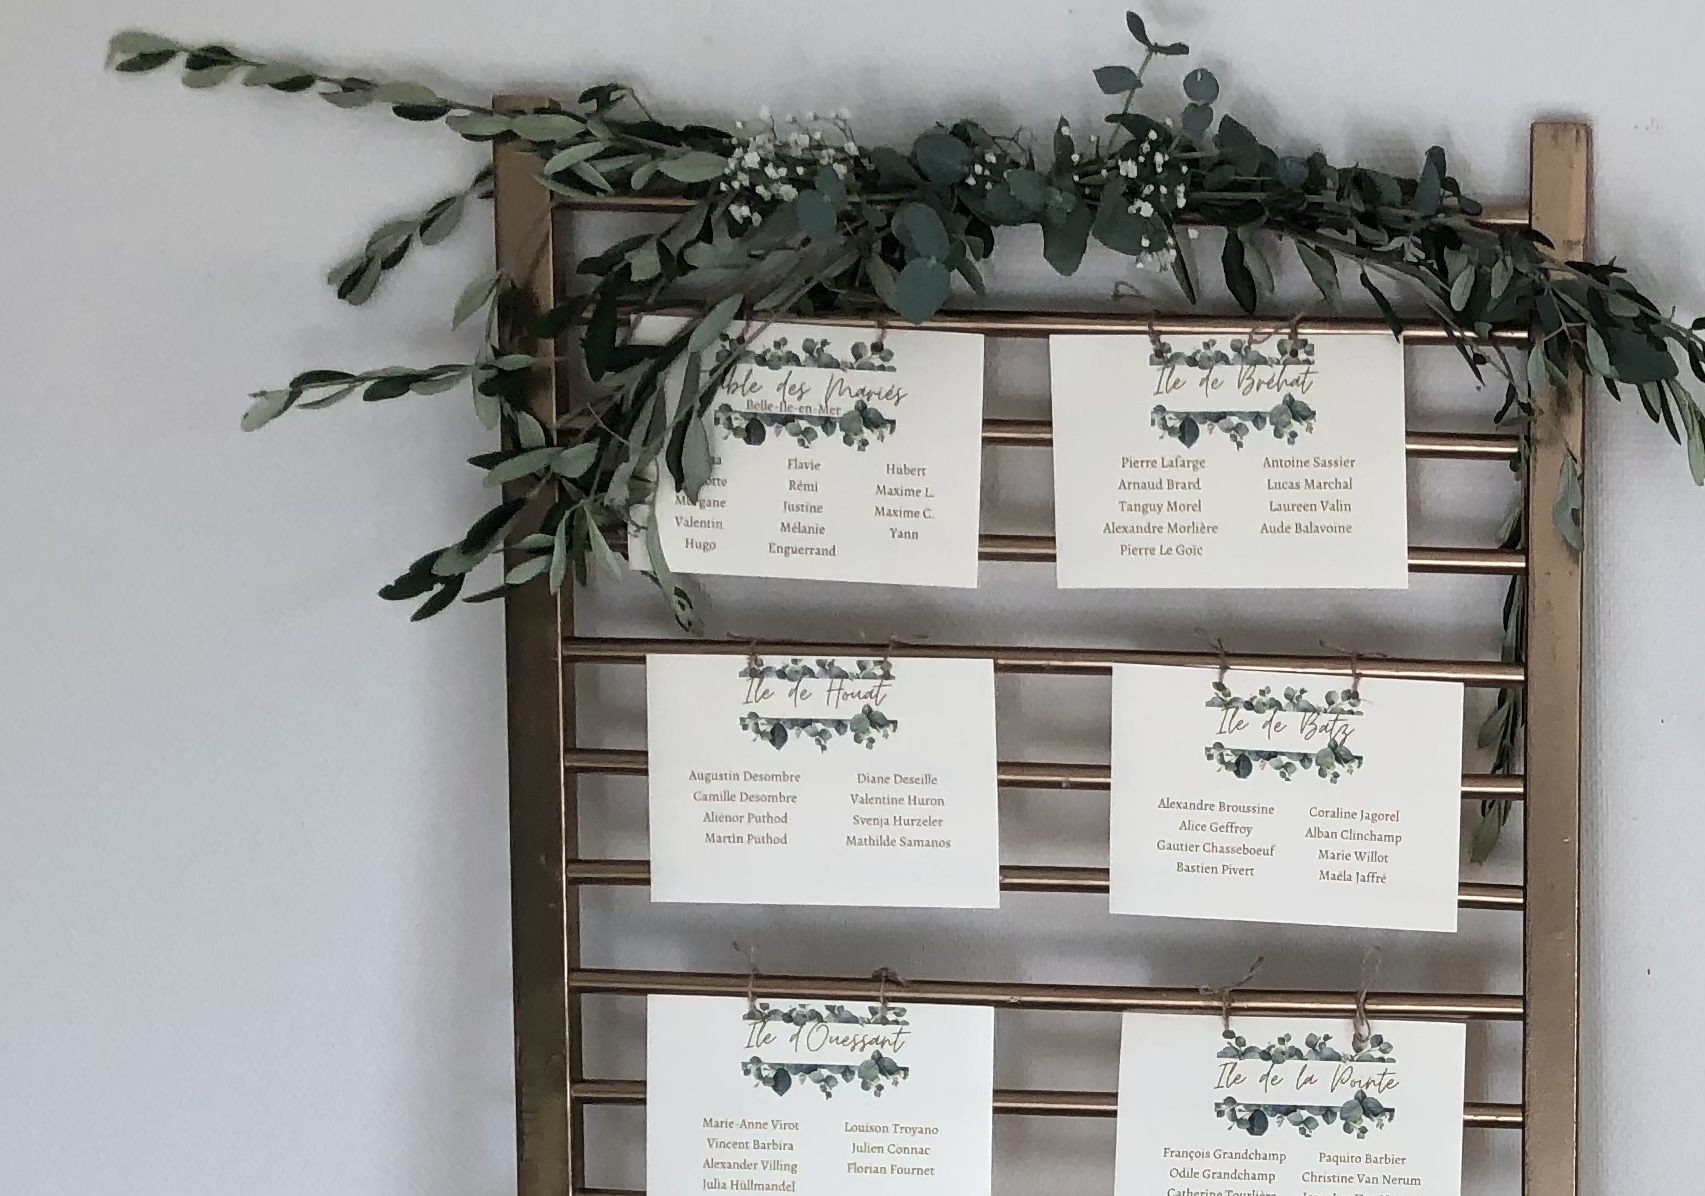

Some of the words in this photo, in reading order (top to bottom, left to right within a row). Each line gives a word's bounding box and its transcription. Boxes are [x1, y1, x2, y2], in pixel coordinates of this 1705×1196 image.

[1199, 364, 1223, 398] de
[1238, 364, 1319, 396] Bréhat
[776, 371, 811, 407] des
[788, 457, 821, 471] Flavie
[886, 463, 926, 477] Hubert
[1122, 456, 1157, 469] Pierre
[1161, 455, 1205, 472] Lafarge
[1267, 478, 1301, 490] Lucas
[1304, 477, 1353, 490] Marchal
[783, 500, 823, 513] Justine
[1118, 501, 1163, 515] Tanguy
[1167, 499, 1201, 513] Morel
[675, 515, 723, 530] Valentin
[889, 527, 919, 540] Yann
[685, 537, 716, 553] Hugo
[787, 678, 812, 708] de
[825, 677, 893, 710] Houat
[1262, 708, 1287, 741] de
[1300, 711, 1356, 745] Batz
[689, 770, 740, 784] Augustin
[743, 770, 801, 782] Desombre
[857, 772, 891, 784] Diane
[893, 773, 938, 785] Deseille
[1179, 819, 1207, 832] Alice
[1209, 821, 1253, 838] Geffroy
[705, 832, 743, 844] Martin
[747, 832, 788, 845] Puthod
[1318, 849, 1351, 861] Marie
[1354, 850, 1389, 864] Willot
[1176, 861, 1218, 875] Bastien
[1222, 864, 1255, 876] Pivert
[1259, 1063, 1283, 1094] de
[1295, 1065, 1319, 1091] la
[1330, 1065, 1400, 1094] Pointe
[845, 1121, 889, 1134] Louison
[892, 1123, 939, 1137] Troyano
[707, 1137, 750, 1150] Vincent
[753, 1139, 794, 1151] Barbira
[847, 1161, 887, 1174] Florian
[890, 1164, 935, 1176] Fournet
[1302, 1170, 1354, 1184] Christine
[1357, 1173, 1379, 1185] Van
[1382, 1174, 1421, 1186] Nerum
